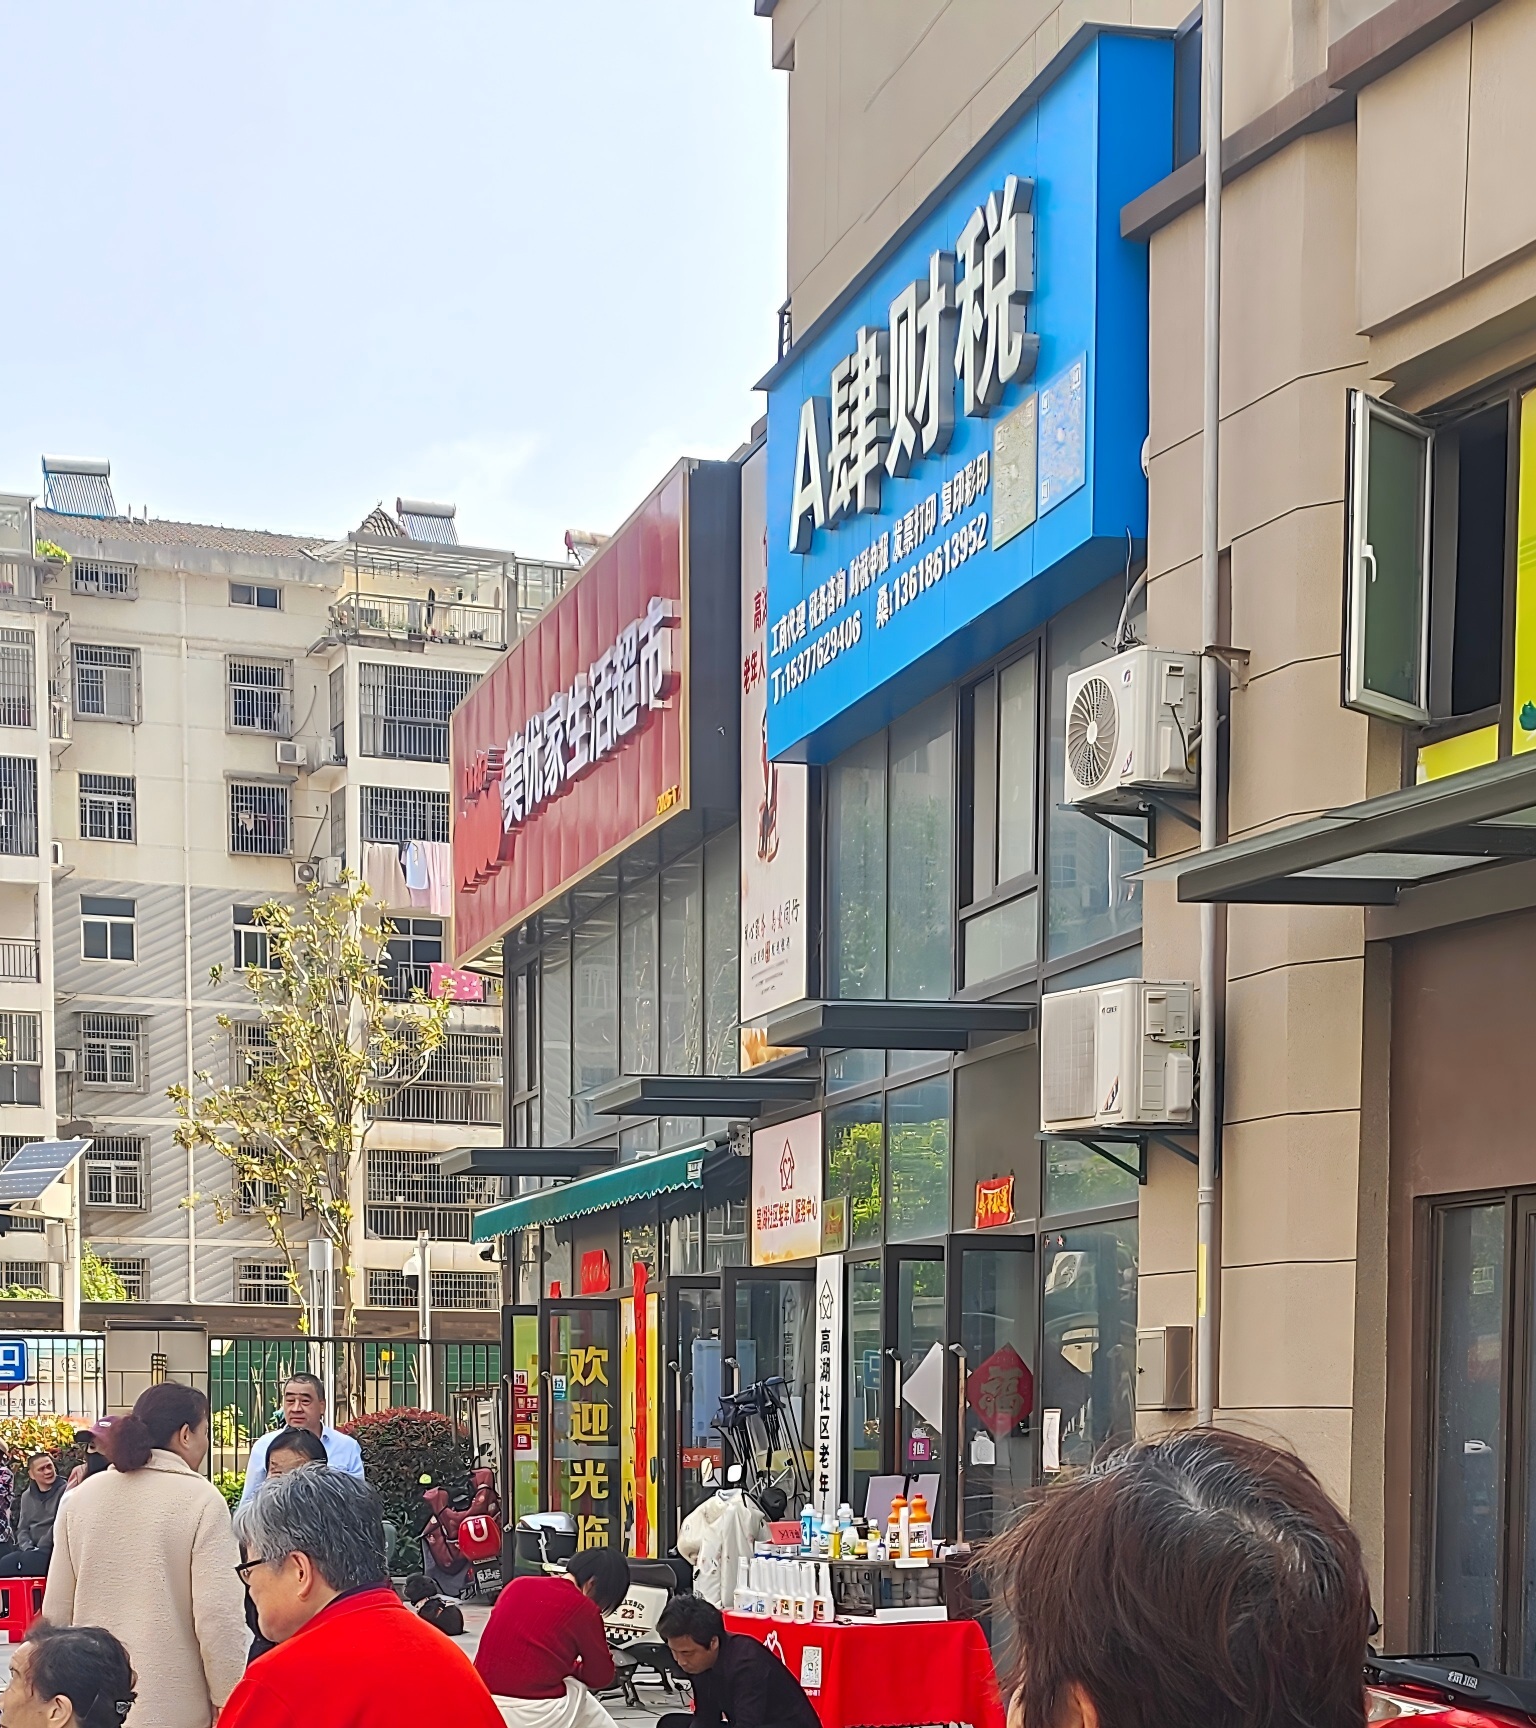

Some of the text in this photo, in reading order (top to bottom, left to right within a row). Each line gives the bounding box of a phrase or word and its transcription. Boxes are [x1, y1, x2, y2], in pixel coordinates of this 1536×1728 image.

[503, 597, 681, 834] 美优家生活超市
[569, 1345, 610, 1551] 欢迎光临
